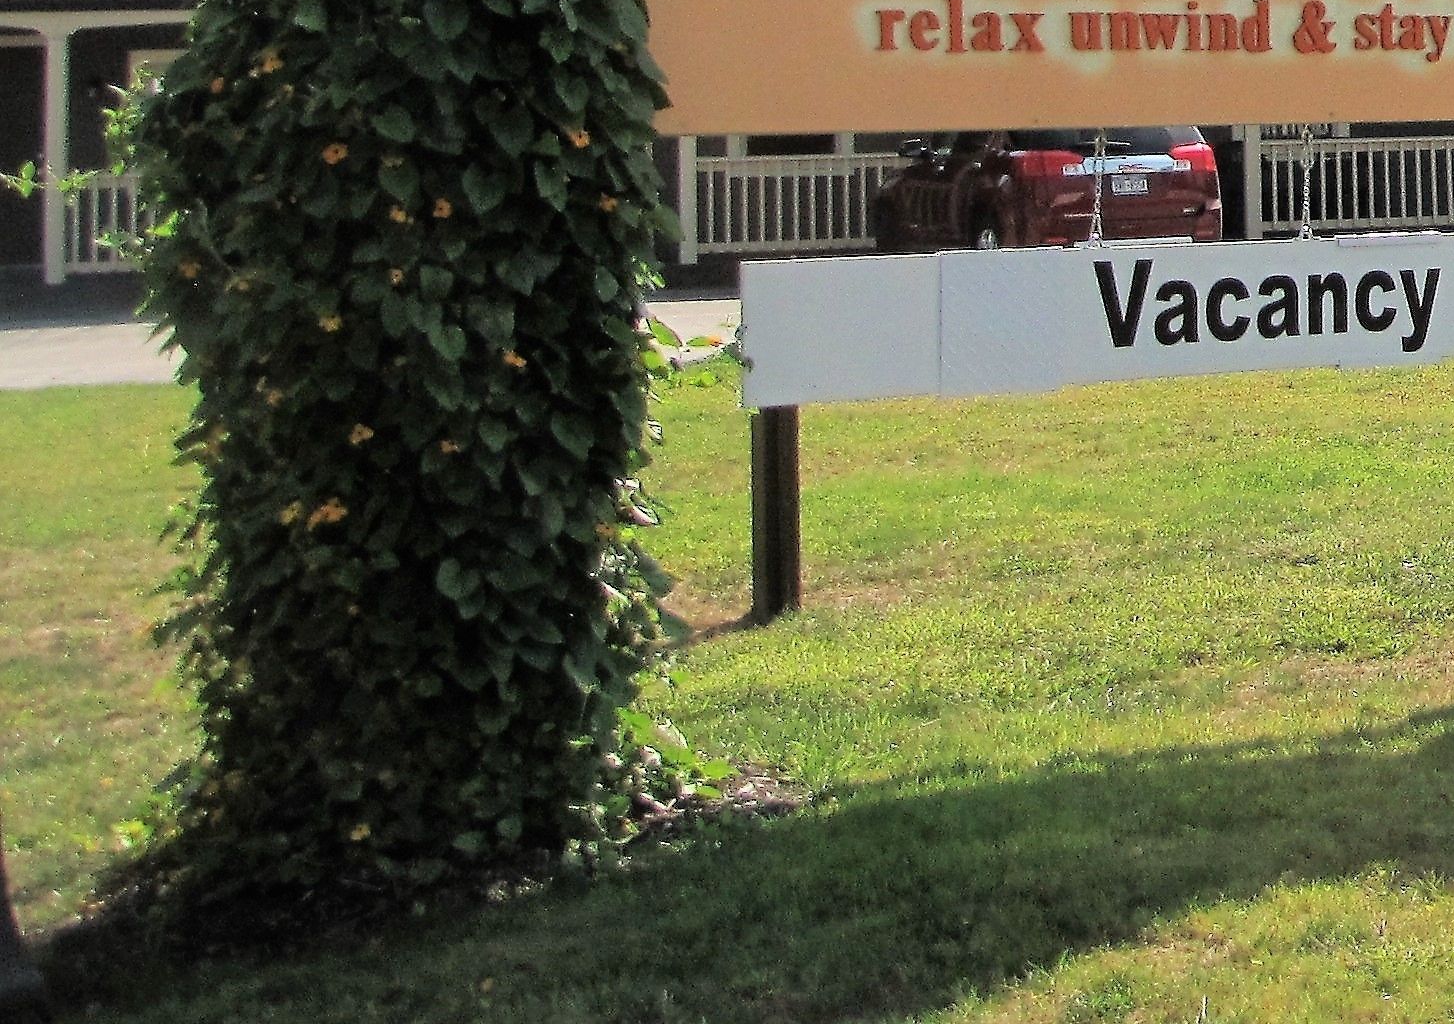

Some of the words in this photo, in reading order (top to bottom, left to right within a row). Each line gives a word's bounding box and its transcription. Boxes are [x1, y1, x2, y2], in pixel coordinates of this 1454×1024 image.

[1069, 0, 1271, 54] unwind
[1292, 0, 1339, 56] &
[1353, 3, 1451, 62] stay
[1092, 258, 1442, 353] Vacancy
